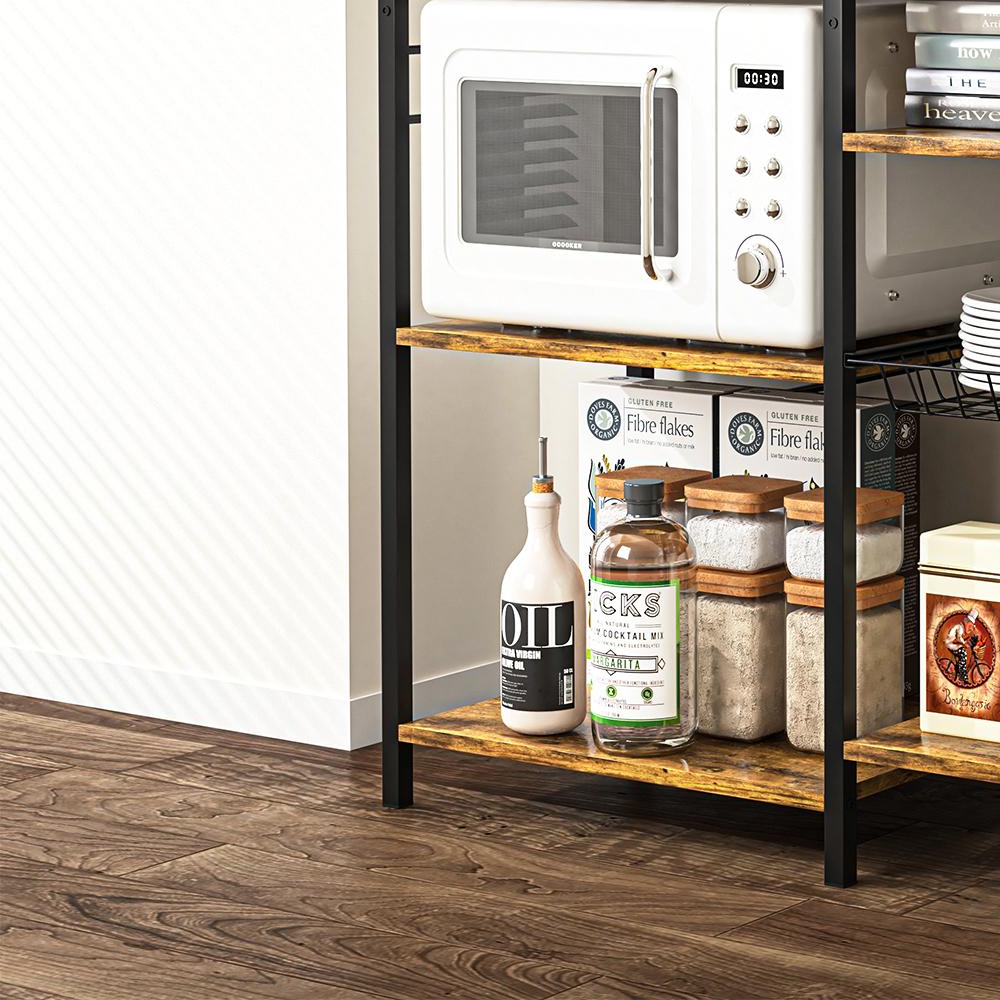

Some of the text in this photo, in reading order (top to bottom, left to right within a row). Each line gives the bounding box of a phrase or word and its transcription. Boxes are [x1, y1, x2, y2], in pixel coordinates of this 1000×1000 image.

[743, 71, 779, 86] 00:30
[949, 76, 987, 88] THE
[628, 398, 673, 409] GLUTEN FREE
[588, 401, 620, 424] DOVES FARM
[771, 411, 819, 423] GLUTEN FREE
[590, 425, 619, 439] ORGANIC
[627, 413, 694, 438] Fibre flakes
[730, 414, 762, 437] DOVES FARM
[731, 438, 761, 454] ORGANIC
[770, 427, 825, 451] Fibre flak
[594, 590, 662, 618] CKS
[501, 602, 574, 649] OIL
[603, 629, 647, 641] COCKTAIL
[651, 631, 664, 640] MIX
[515, 649, 541, 660] VIRGIN
